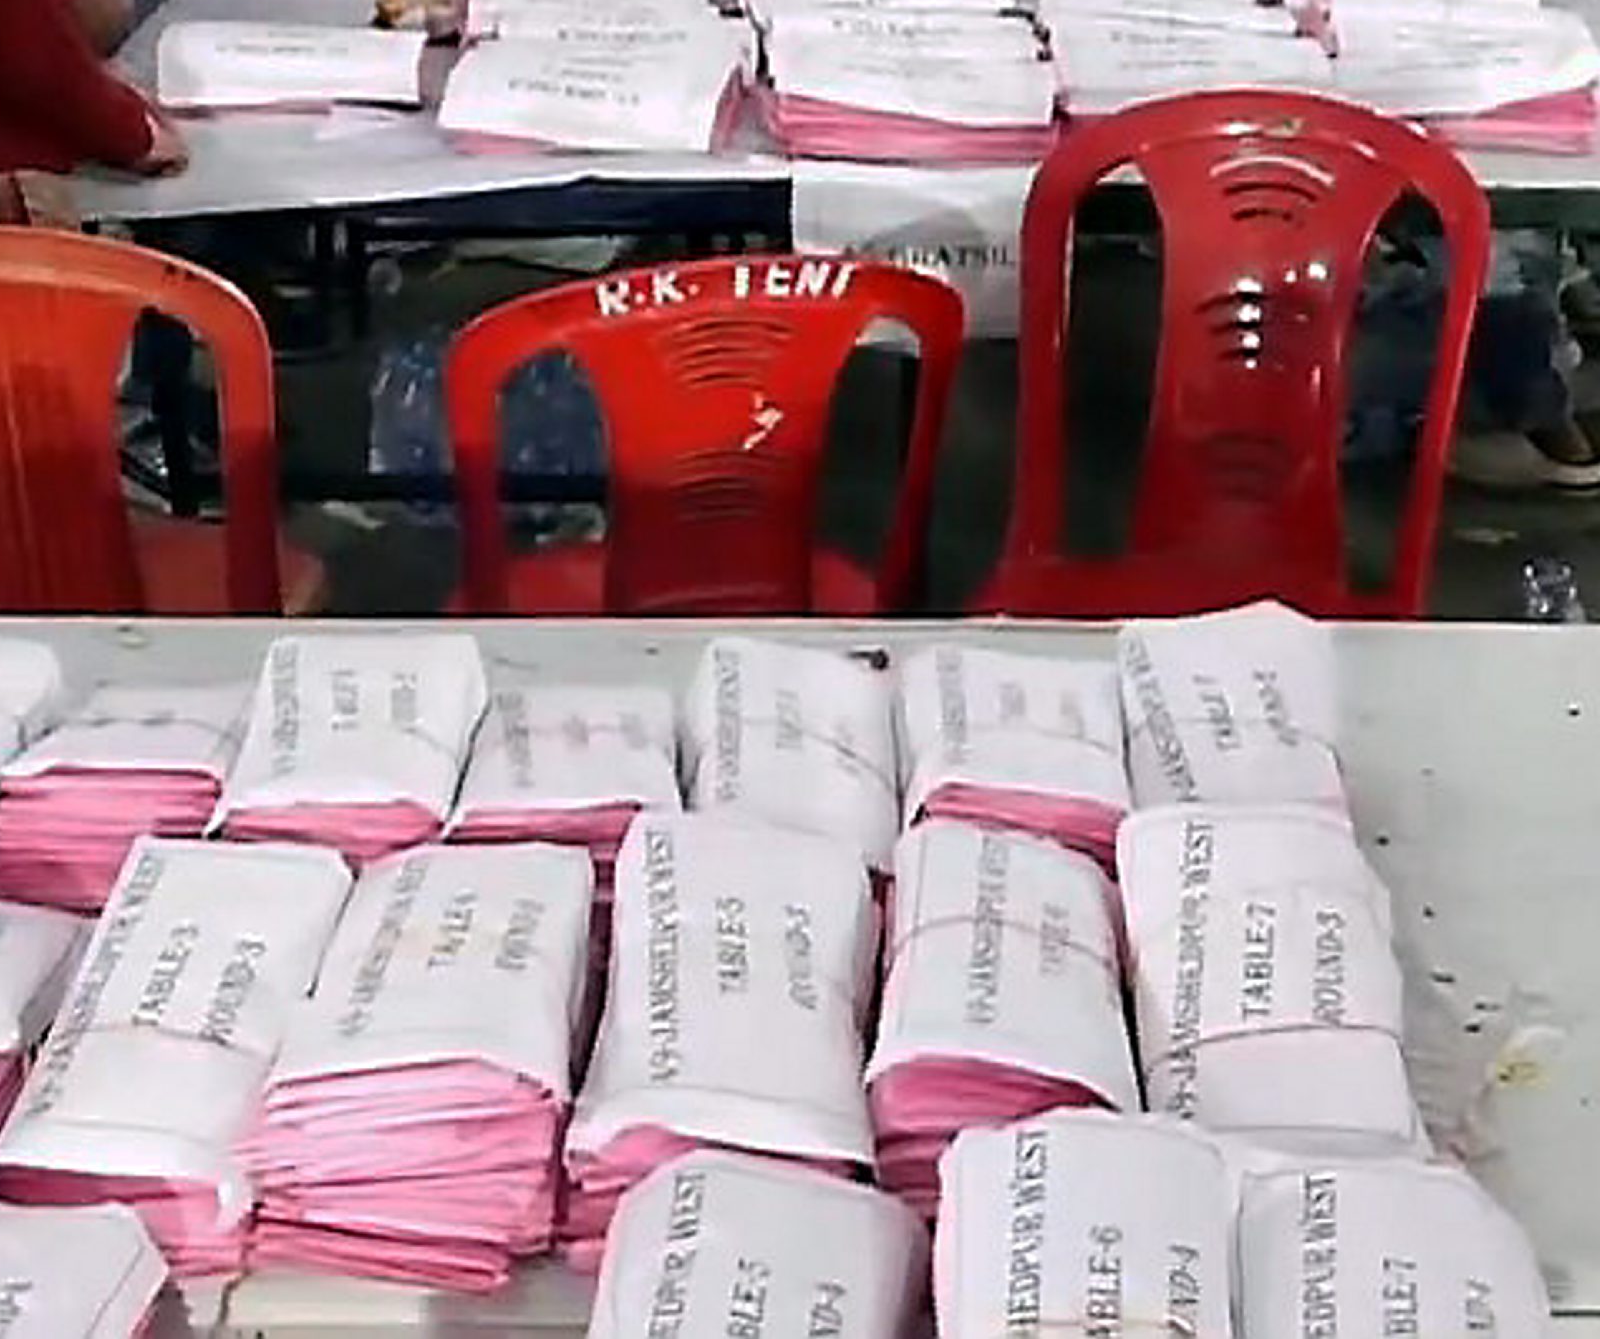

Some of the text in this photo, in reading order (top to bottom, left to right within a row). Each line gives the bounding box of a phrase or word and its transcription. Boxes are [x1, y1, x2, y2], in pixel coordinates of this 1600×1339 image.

[1180, 821, 1213, 886] WEST
[1242, 902, 1275, 1020] TABLE-7
[1013, 1131, 1048, 1206] WEST
[671, 1173, 705, 1240] WEST
[1305, 1174, 1336, 1242] WEST
